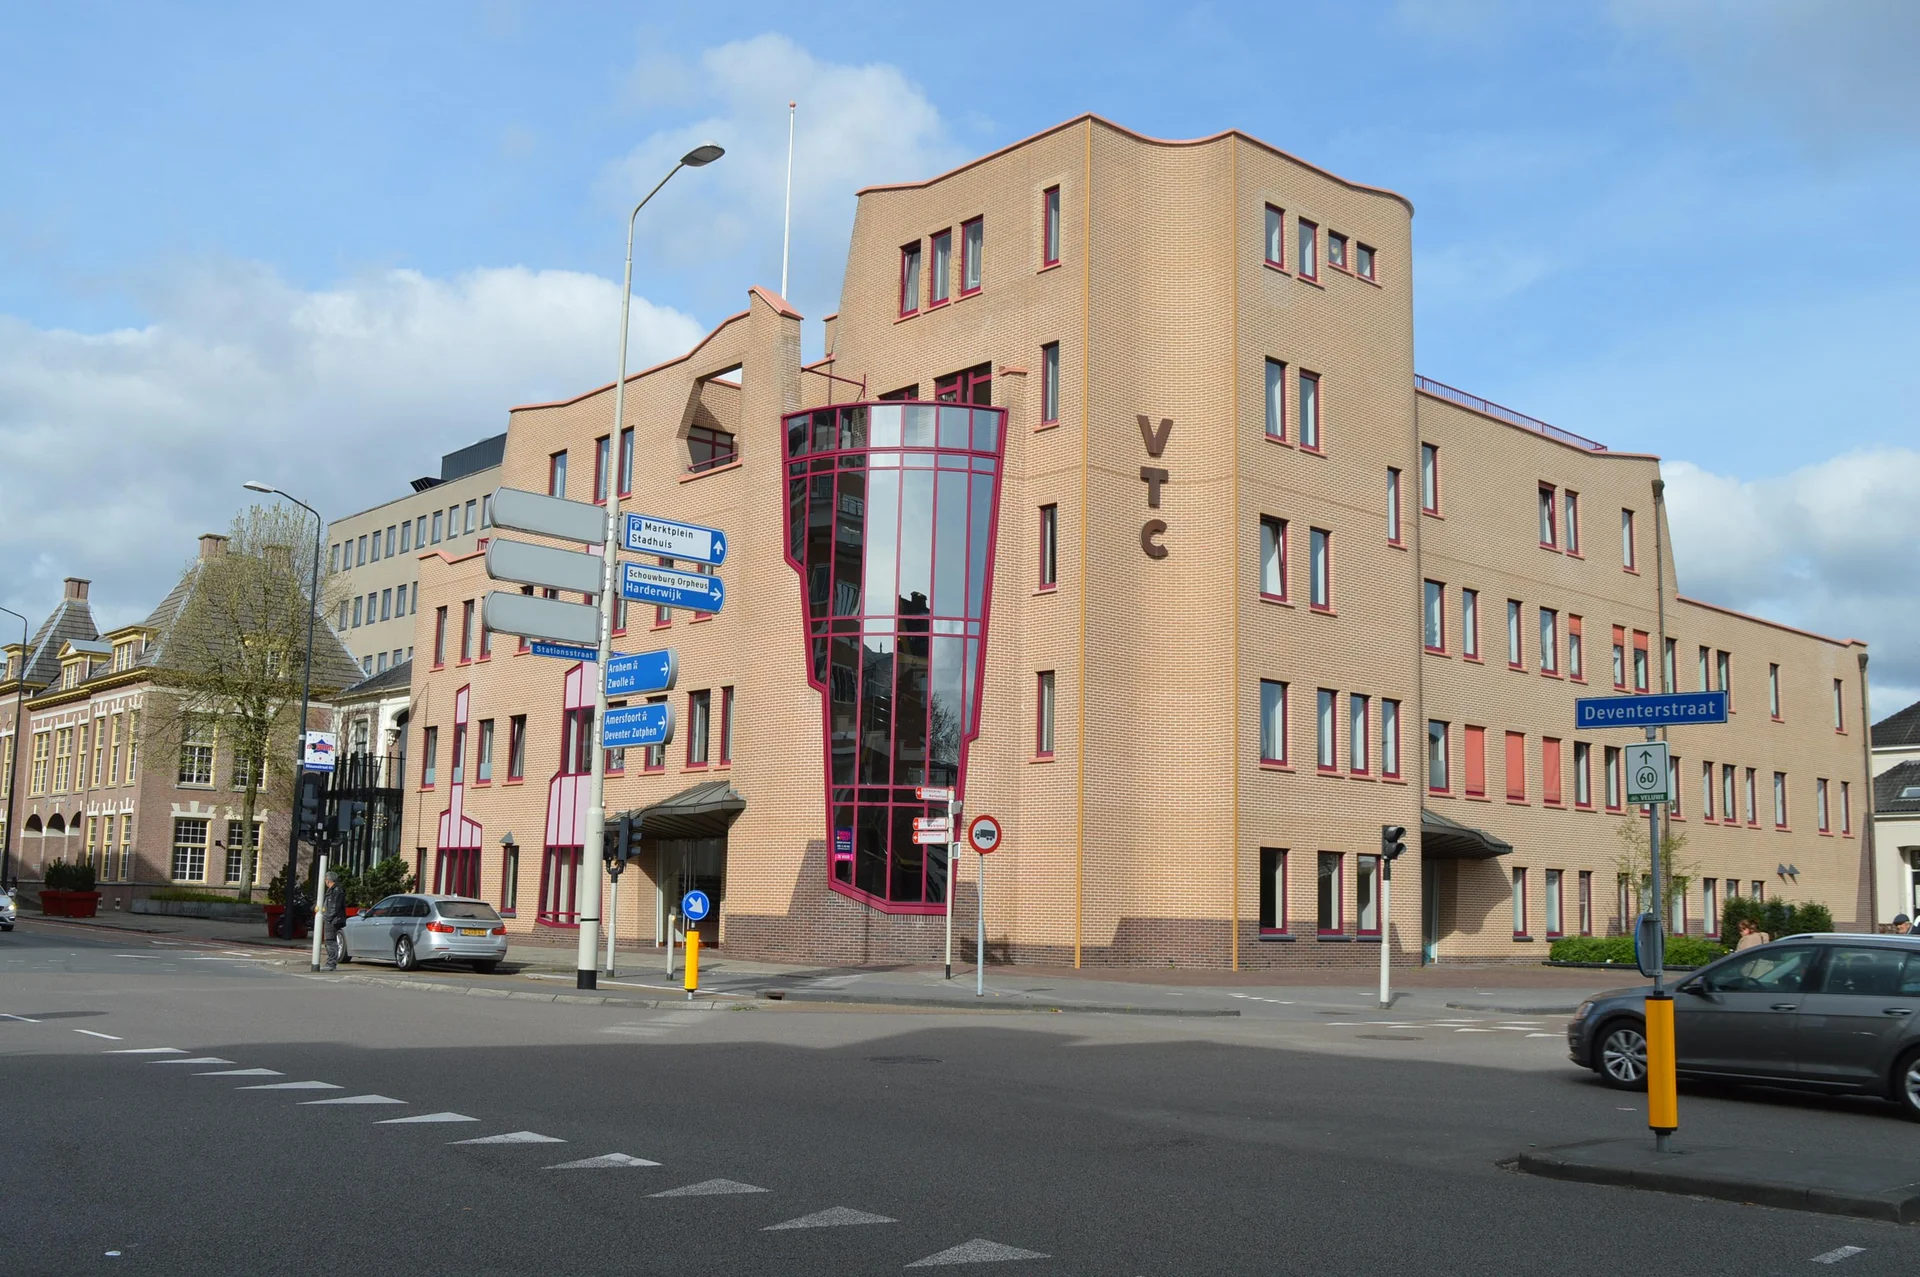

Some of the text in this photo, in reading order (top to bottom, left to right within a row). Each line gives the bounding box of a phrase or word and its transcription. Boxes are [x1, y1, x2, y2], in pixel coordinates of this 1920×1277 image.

[1137, 414, 1173, 560] VTC
[644, 522, 693, 539] Marktplein
[631, 533, 672, 549] Stadhuis
[629, 569, 708, 590] Schouwburg Orpheus
[626, 582, 682, 601] Harderwijk
[536, 645, 593, 659] Stationsstraat
[608, 661, 632, 674] Arnhem
[607, 677, 629, 689] Zwolle
[605, 712, 642, 725] Amersfoort
[1584, 701, 1716, 721] Deventerstraat
[604, 727, 657, 741] Deventer Zutphen
[1639, 772, 1655, 784] 60
